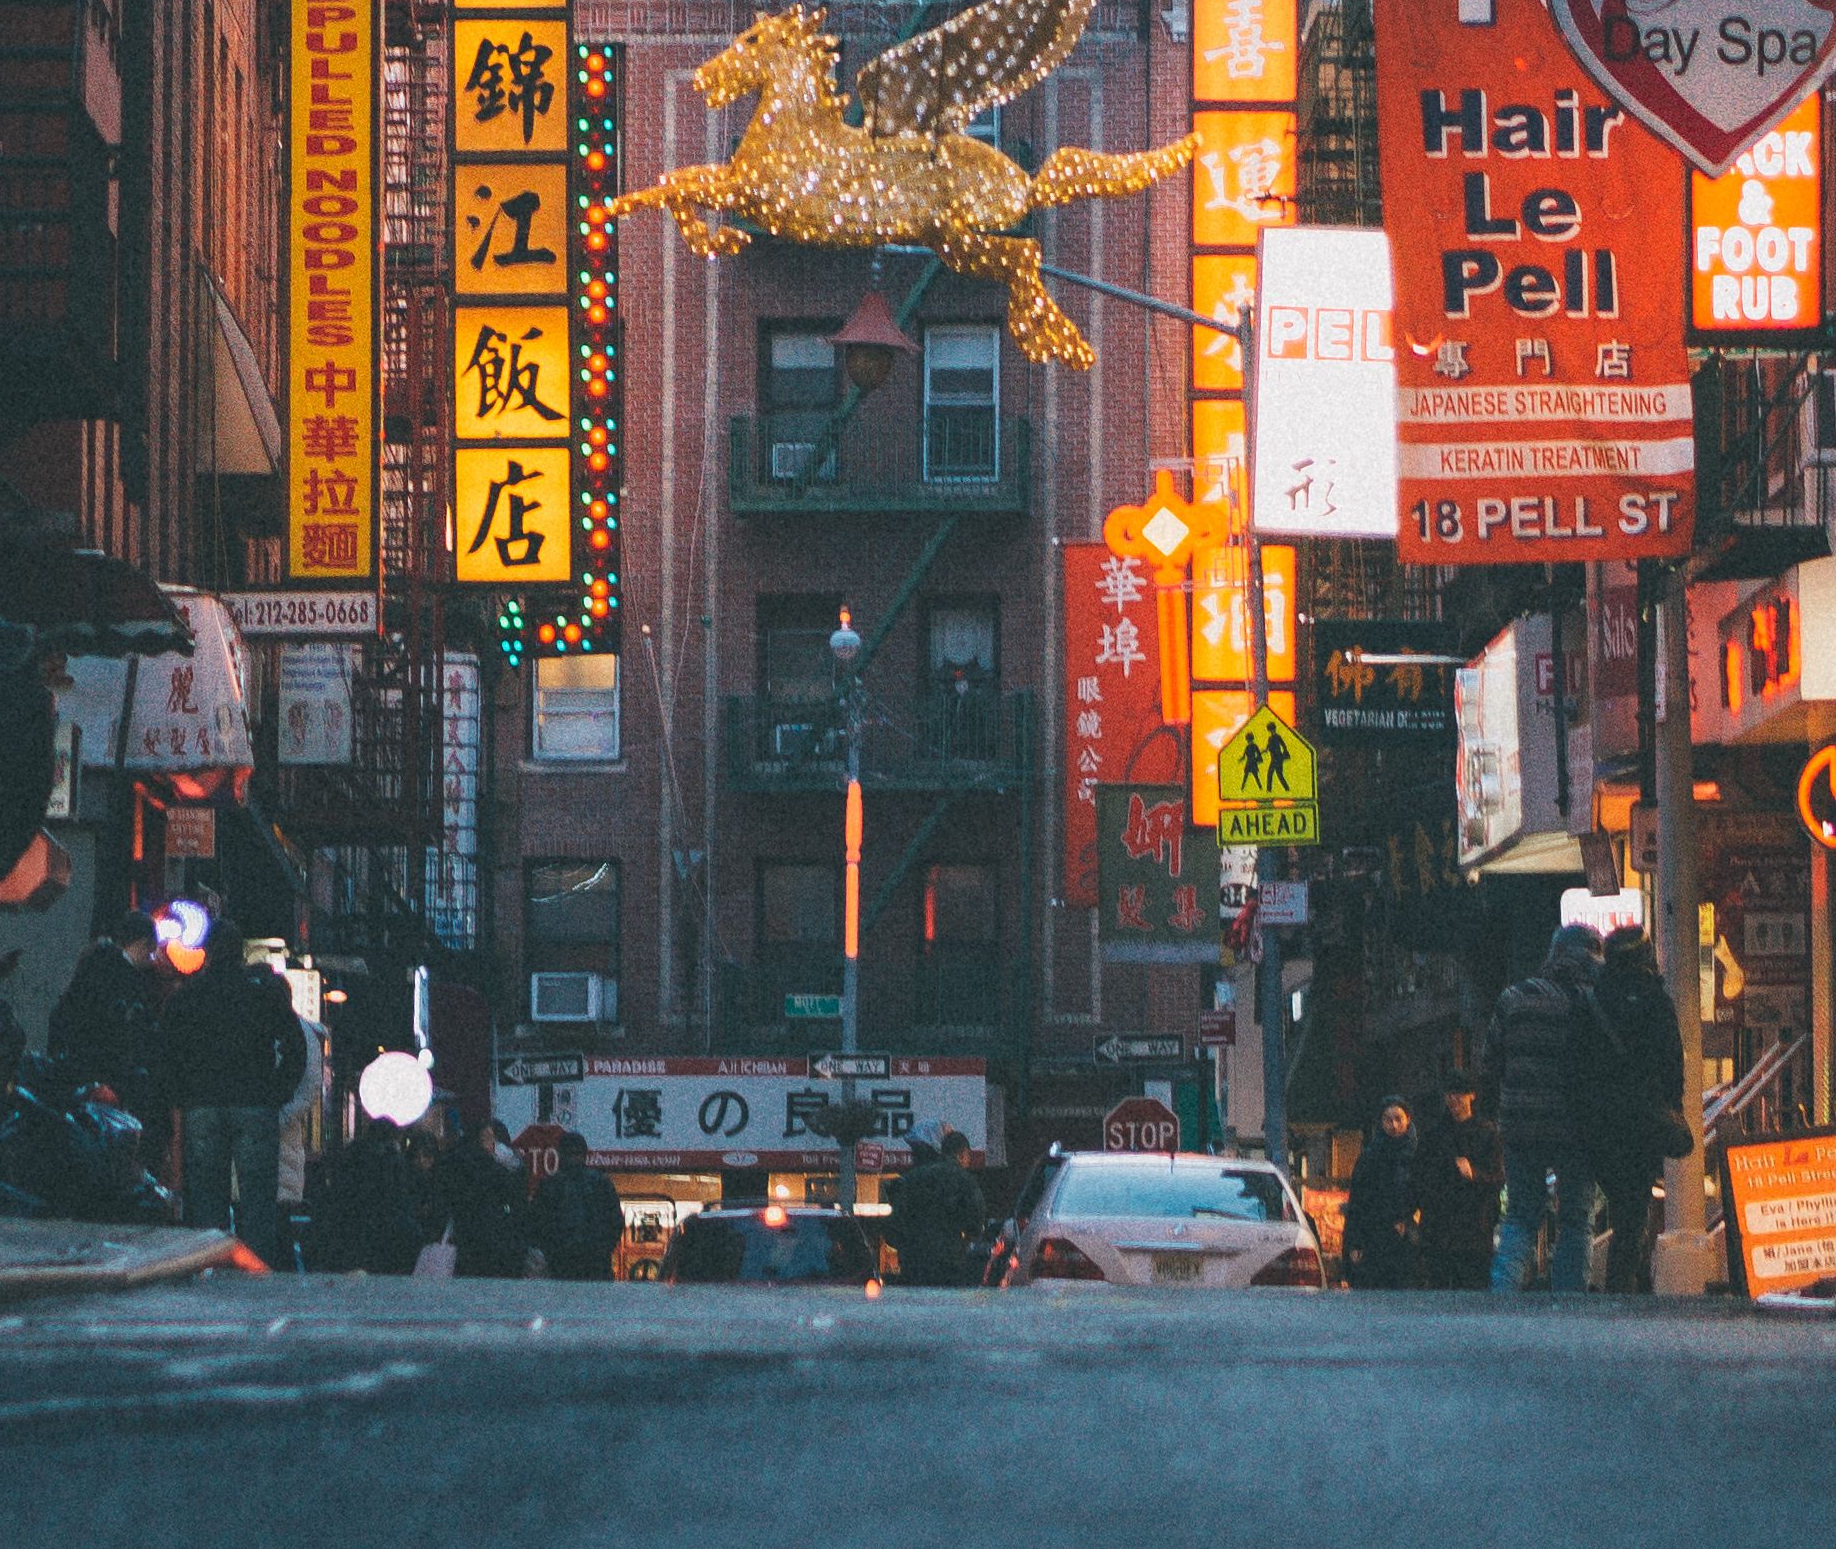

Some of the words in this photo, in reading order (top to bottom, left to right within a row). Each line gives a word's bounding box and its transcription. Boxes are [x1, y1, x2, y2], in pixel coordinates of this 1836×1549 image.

[1603, 16, 1700, 76] Day
[1716, 16, 1818, 77] Spa
[1421, 88, 1626, 160] Hair
[1465, 170, 1582, 242] Le
[1738, 179, 1773, 226] &
[302, 169, 359, 347] NOODLES
[1697, 227, 1814, 273] FOOT
[461, 31, 568, 567] 錦江飯店
[1441, 249, 1620, 320] Pell
[1712, 276, 1799, 321] RUB
[1410, 391, 1509, 417] JAPANESE
[1514, 389, 1667, 416] STRAIGHTENING
[1440, 447, 1525, 473] KERATIN
[1532, 444, 1643, 472] TREATMENT
[1411, 499, 1464, 543] 18
[1476, 496, 1603, 541] PELL
[1618, 490, 1679, 536] ST
[1323, 707, 1395, 728] VEGETARIAN
[1230, 811, 1307, 837] AHEAD
[819, 1060, 844, 1074] ONE
[854, 1059, 880, 1074] WAY
[1108, 1121, 1175, 1150] STOP
